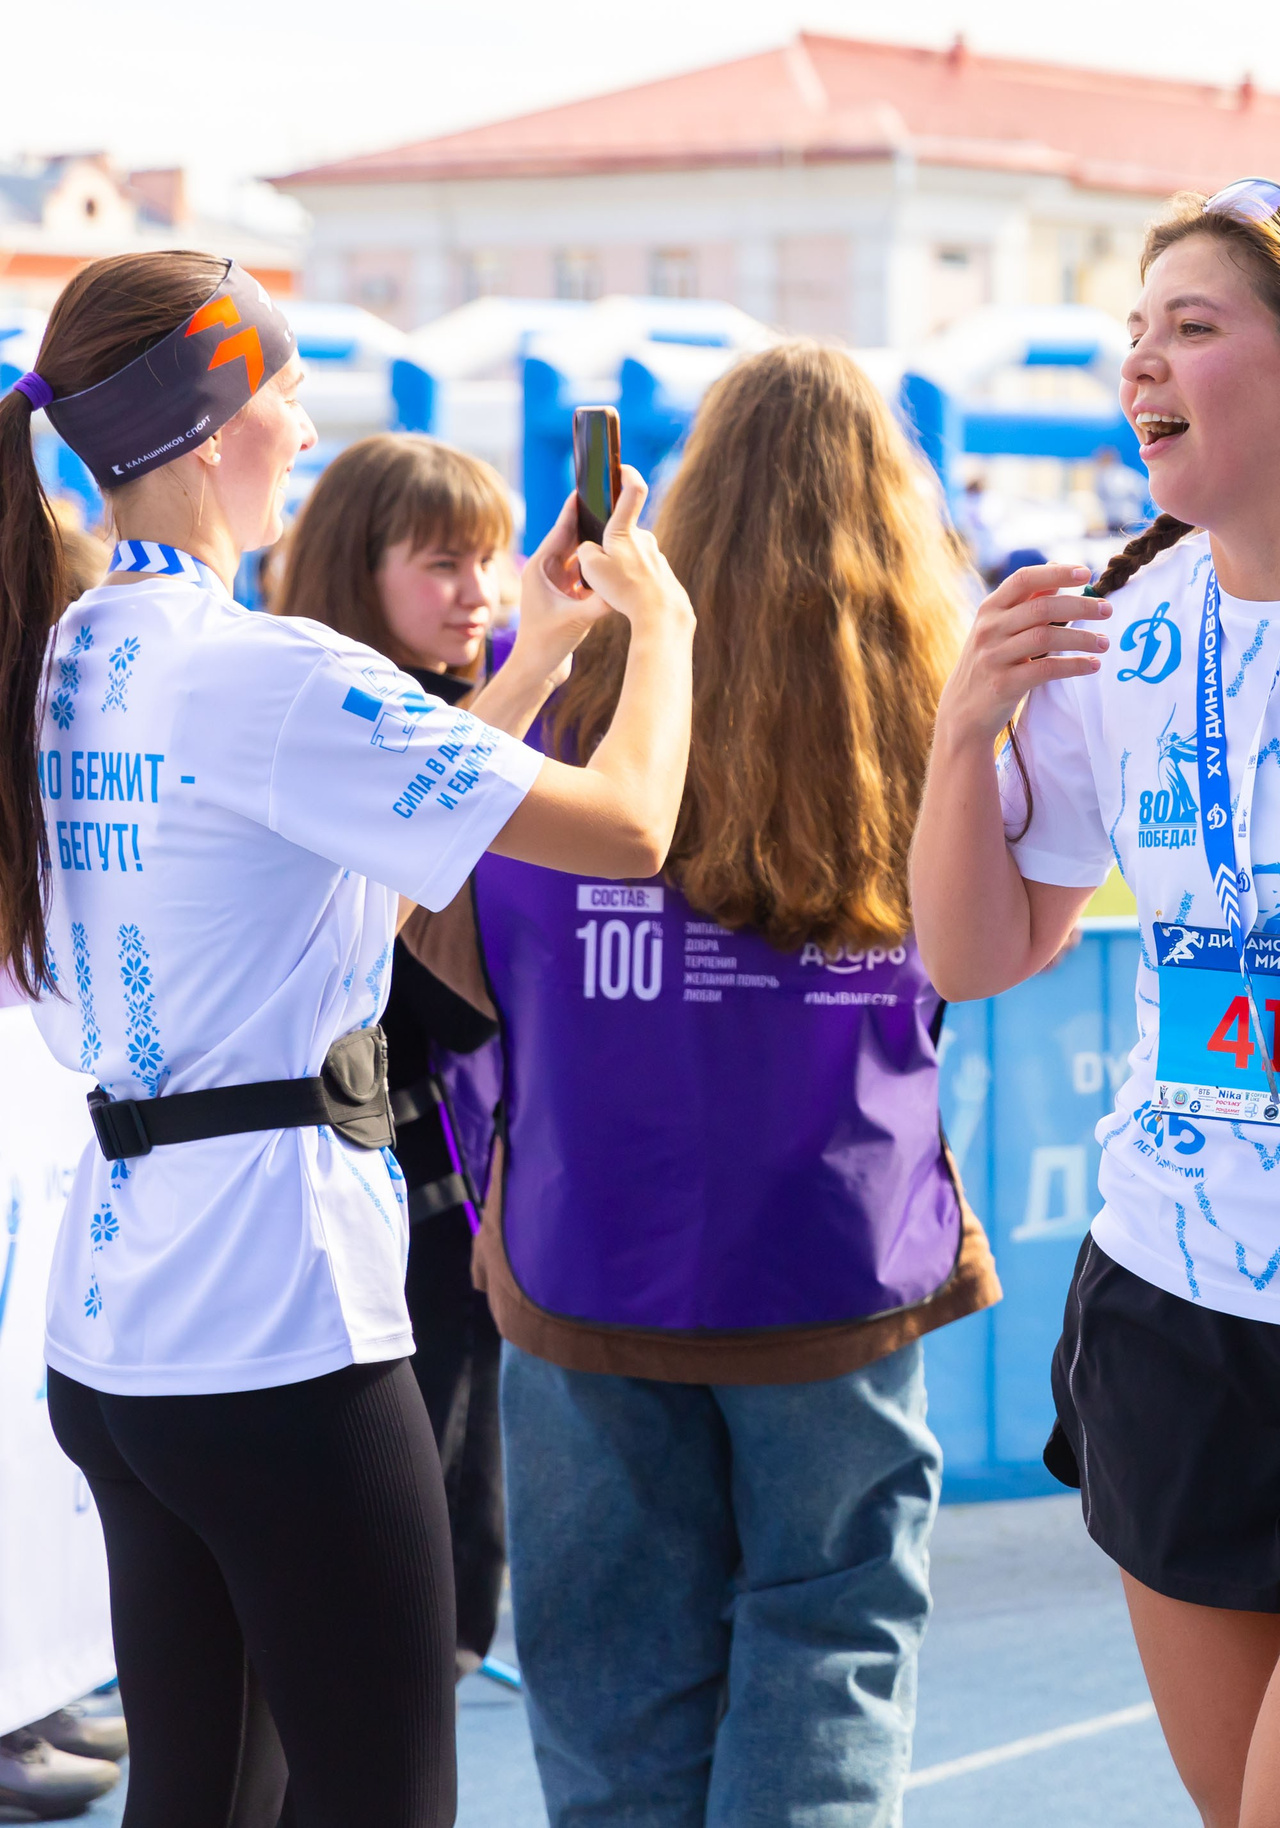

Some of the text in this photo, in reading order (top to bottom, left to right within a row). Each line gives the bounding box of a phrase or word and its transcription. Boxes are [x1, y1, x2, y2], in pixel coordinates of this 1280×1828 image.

[125, 414, 211, 469] КАЛАШНИКОВ СПОРТ
[1204, 566, 1223, 779] XV ДИНАМОВСКА
[71, 751, 165, 803] БЕЖИТ
[392, 773, 437, 819] СИЛА
[425, 758, 446, 776] В
[436, 792, 458, 811] И
[1139, 789, 1170, 825] 80
[56, 820, 144, 872] БЕГУТ!
[1138, 829, 1197, 849] ПОБЕДА!
[591, 888, 650, 908] СОСТАВ:
[1218, 1089, 1242, 1100] Nika
[1133, 1139, 1156, 1157] ЛЕТ
